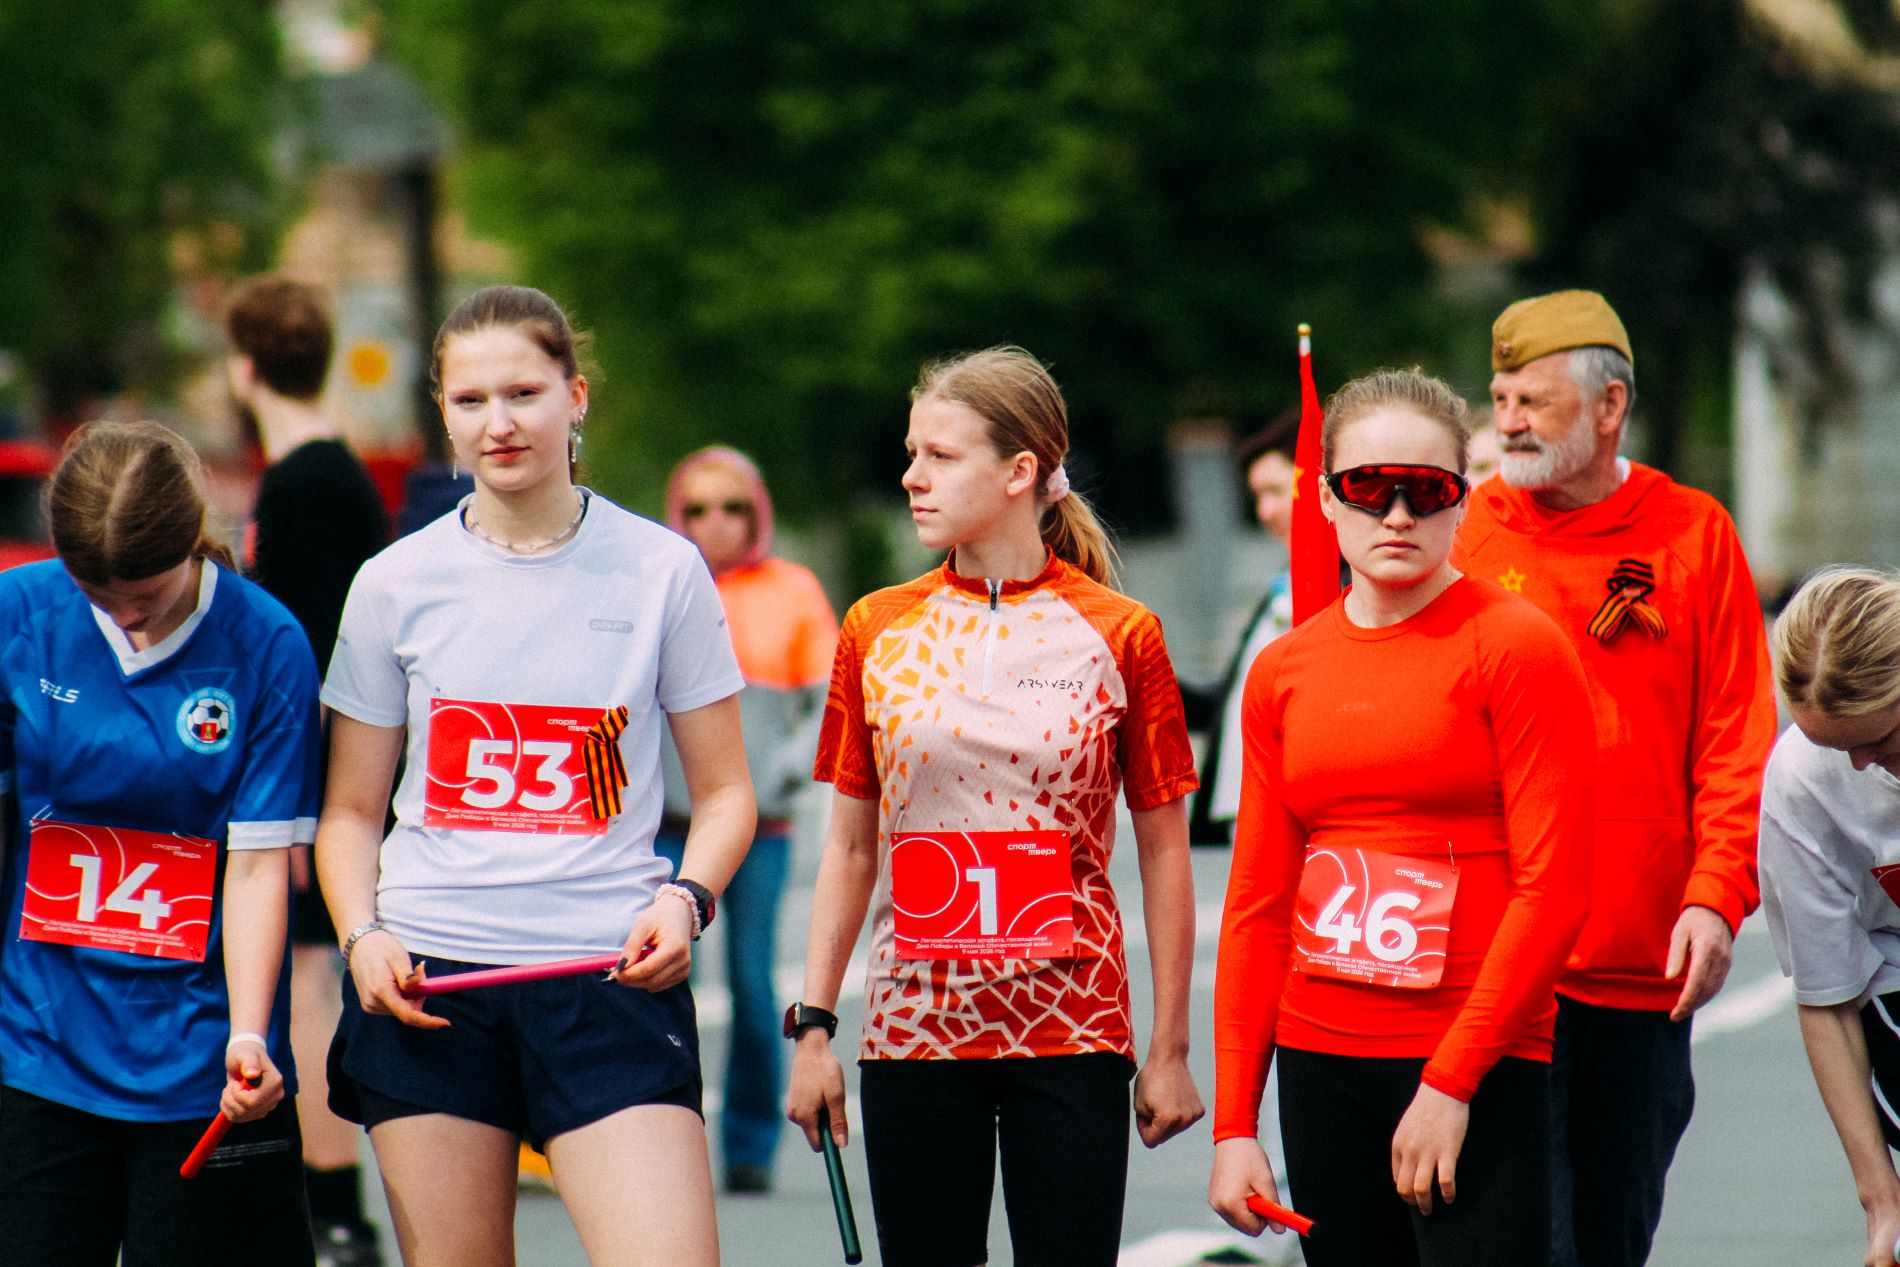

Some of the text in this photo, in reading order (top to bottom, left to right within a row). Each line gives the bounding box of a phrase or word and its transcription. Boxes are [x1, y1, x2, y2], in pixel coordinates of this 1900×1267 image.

[460, 738, 577, 812] 53
[1007, 843, 1037, 851] спорт
[1395, 868, 1425, 879] спорт
[69, 853, 171, 930] 14
[966, 868, 998, 935] 1
[1314, 885, 1422, 962] 46
